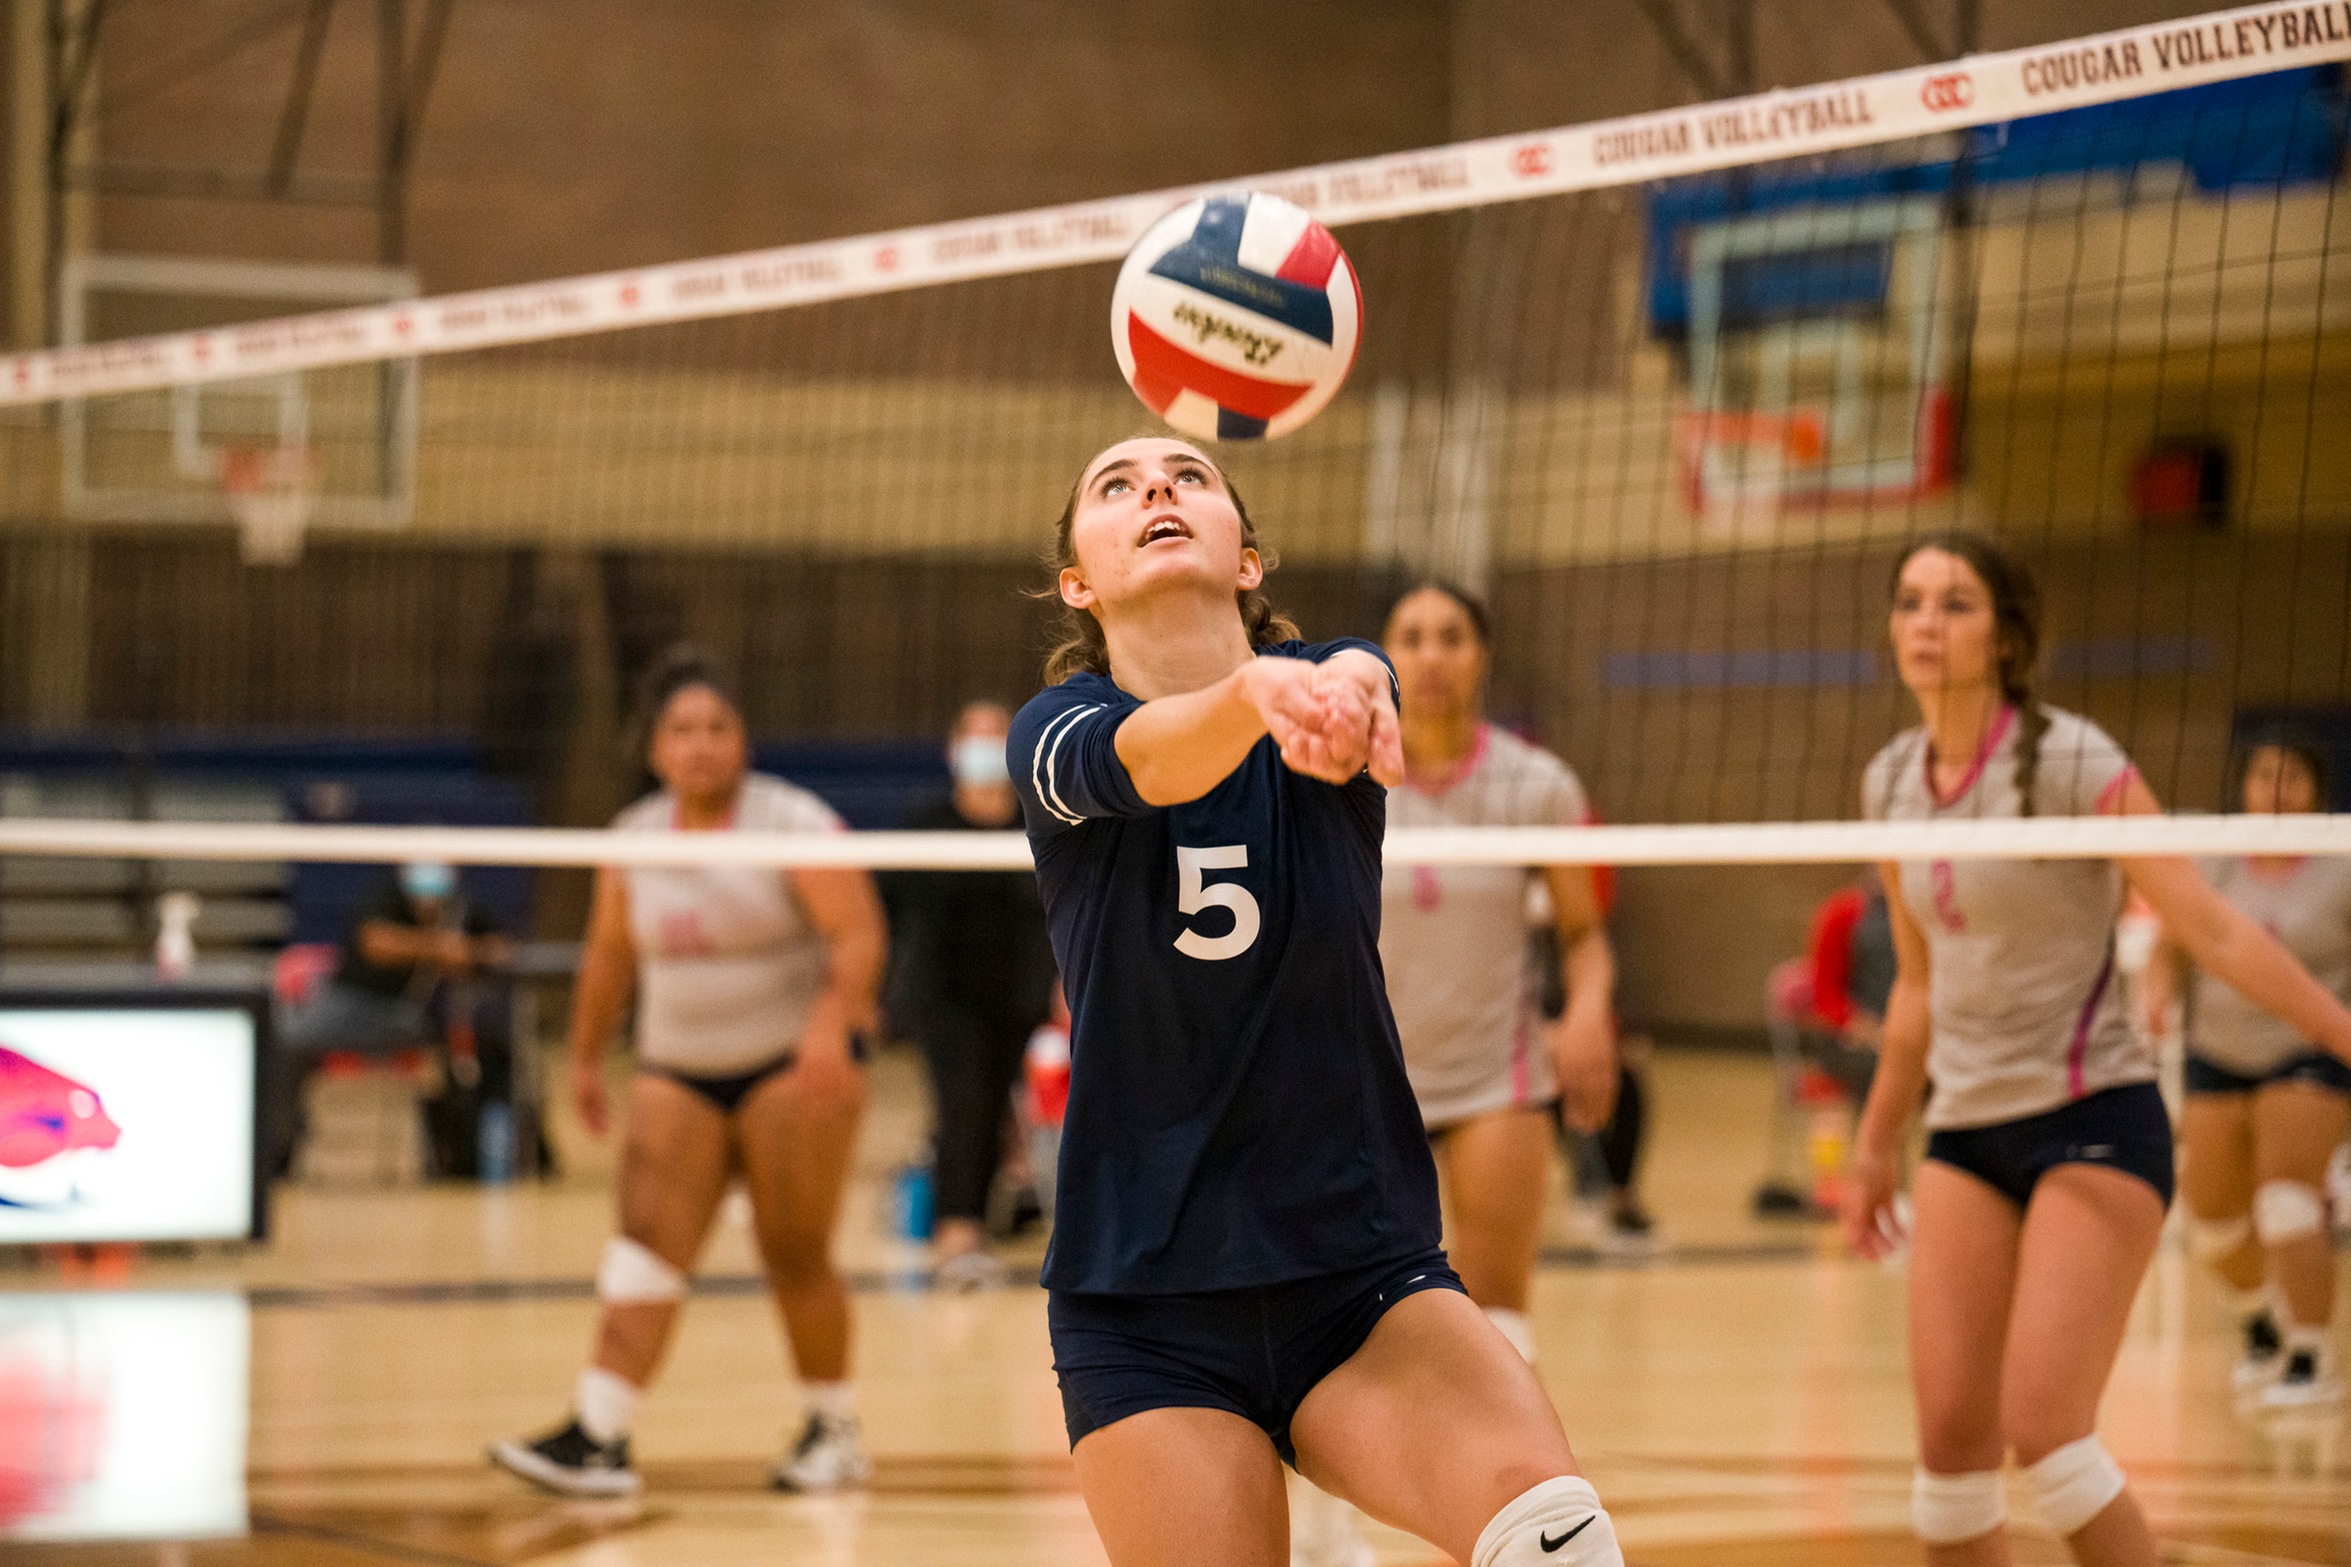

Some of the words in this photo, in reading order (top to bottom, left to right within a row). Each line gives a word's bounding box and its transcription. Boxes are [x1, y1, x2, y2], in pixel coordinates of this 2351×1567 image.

[2021, 39, 2143, 97] COUGAR
[1173, 844, 1260, 961] 5
[1931, 858, 1967, 935] 2
